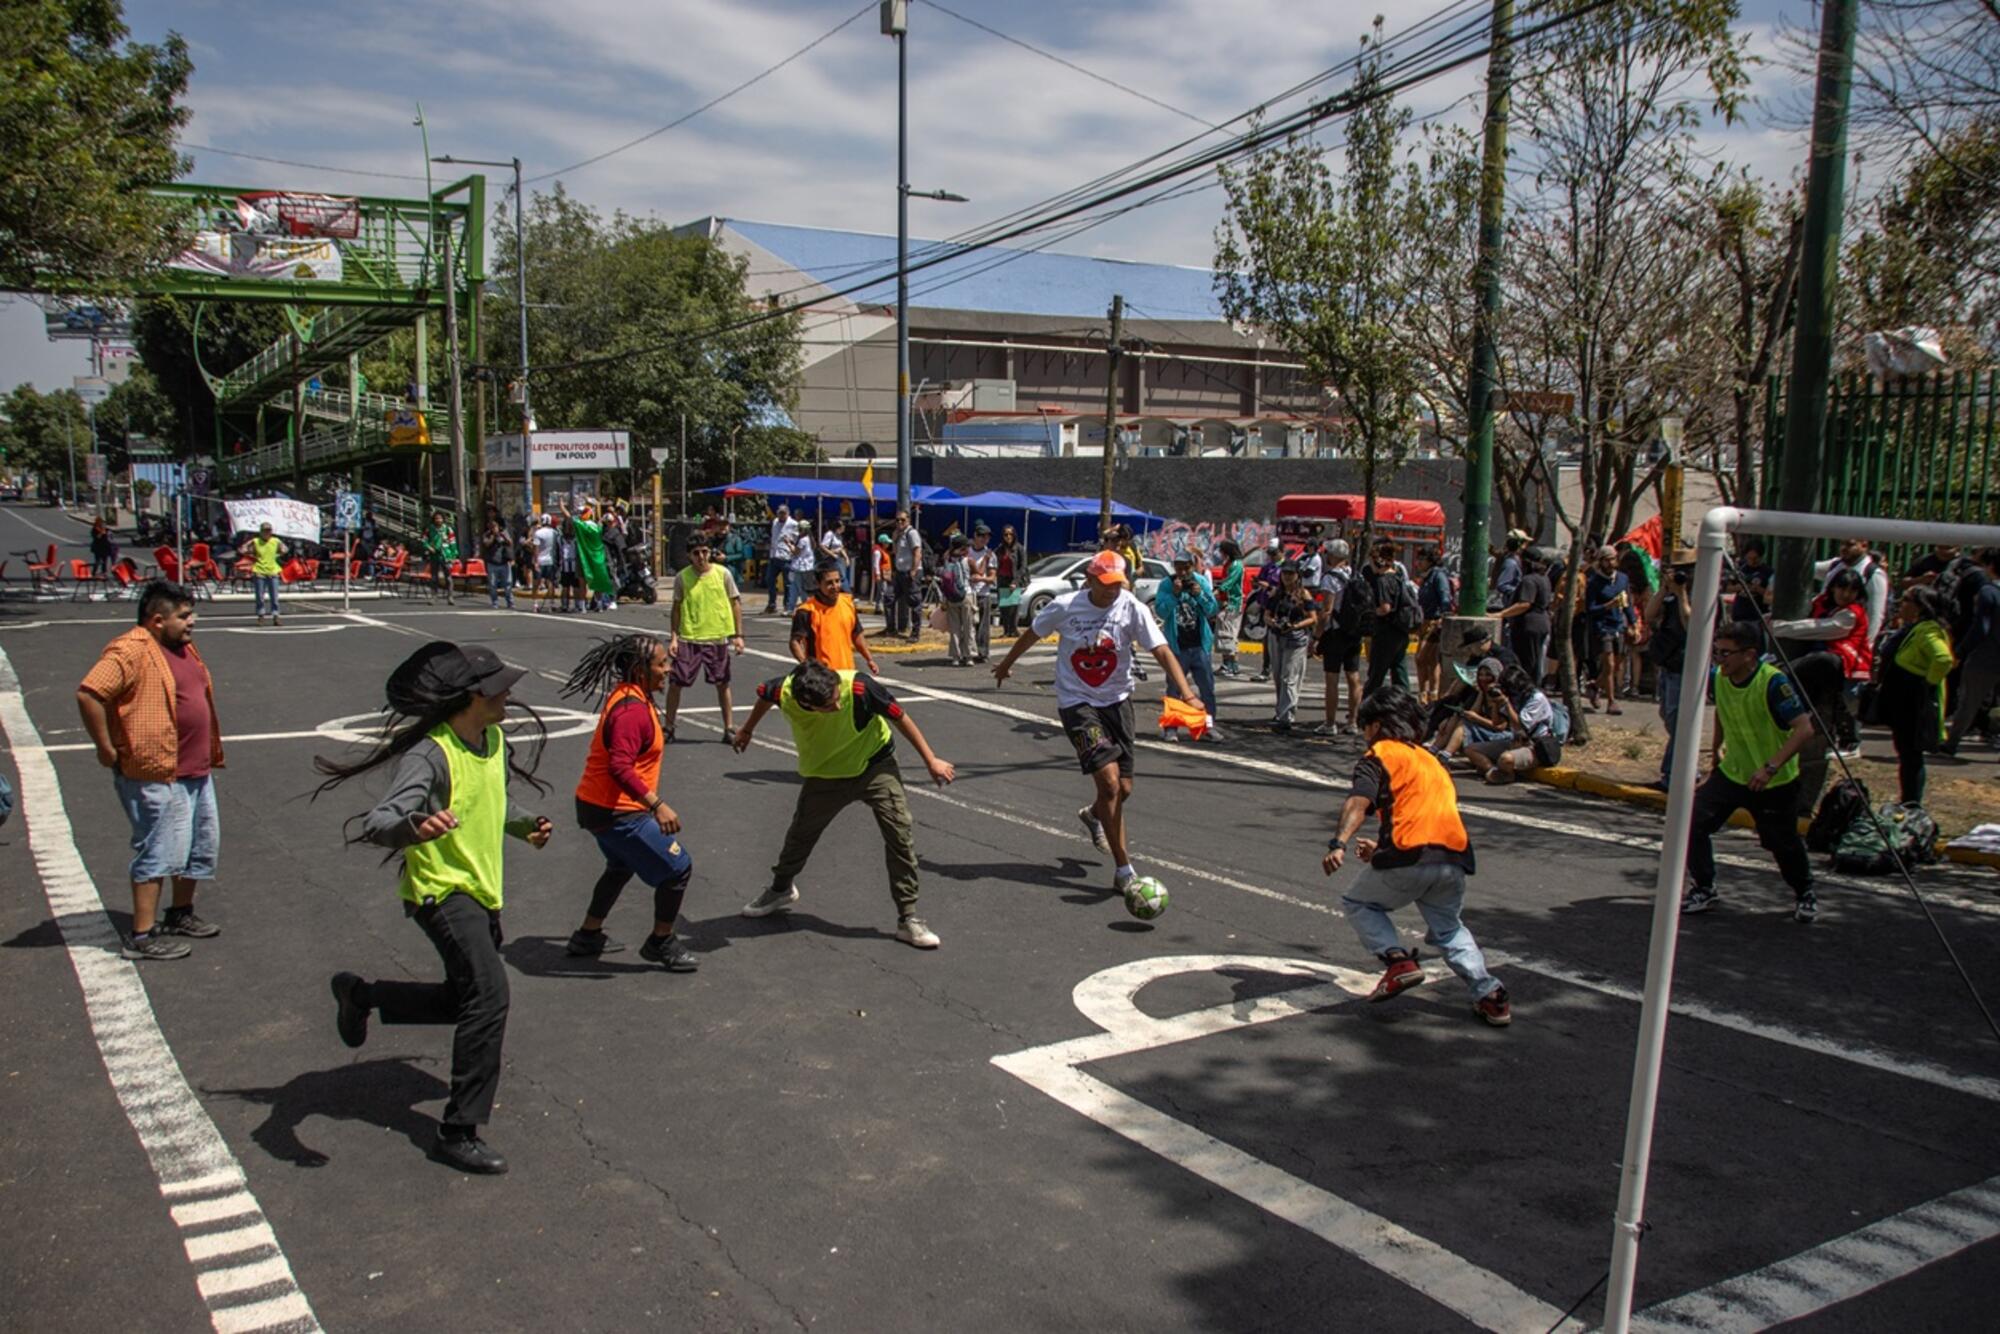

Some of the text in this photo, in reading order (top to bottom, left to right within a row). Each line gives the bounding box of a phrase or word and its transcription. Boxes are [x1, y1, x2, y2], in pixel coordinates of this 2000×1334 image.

[531, 442, 626, 452] LECTROLITOS ORALES
[555, 452, 597, 460] EN POLVO
